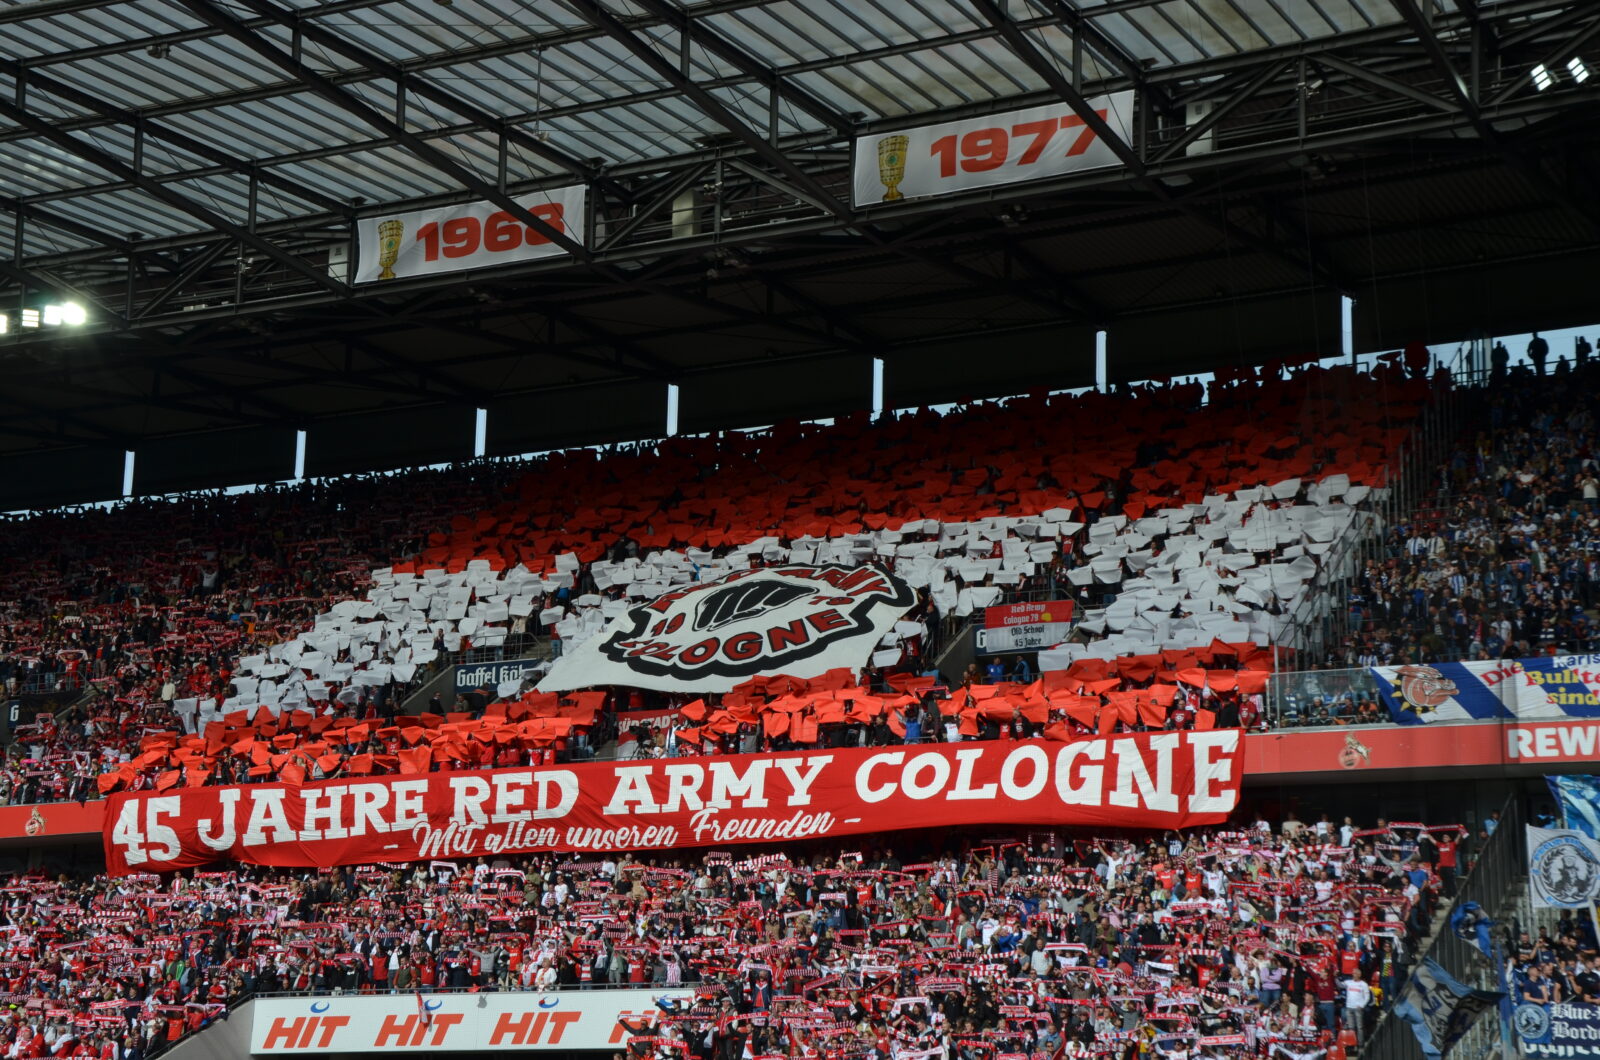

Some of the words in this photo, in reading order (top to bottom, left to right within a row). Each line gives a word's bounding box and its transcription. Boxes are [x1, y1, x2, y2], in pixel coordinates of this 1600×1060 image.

[932, 109, 1107, 177] 1977
[417, 203, 565, 261] 1968
[773, 567, 893, 597] ARMY
[617, 608, 854, 666] COLOGNE
[651, 613, 686, 637] 19
[1011, 626, 1023, 636] Old
[1024, 624, 1045, 634] School
[1015, 638, 1024, 648] 45
[456, 666, 497, 687] Gaffel
[1481, 662, 1525, 687] Die
[1508, 726, 1600, 758] REW
[112, 795, 182, 866] 45
[198, 778, 429, 851] JAHRE
[449, 769, 579, 826] RED
[602, 754, 834, 816] ARMY
[855, 729, 1240, 813] COLOGNE
[412, 820, 478, 858] Mit
[483, 819, 560, 854] allen
[566, 825, 678, 850] unseren
[689, 806, 836, 842] Freunden
[262, 1016, 351, 1049] HIT
[374, 1012, 465, 1046] HIT
[488, 1011, 582, 1045] HIT
